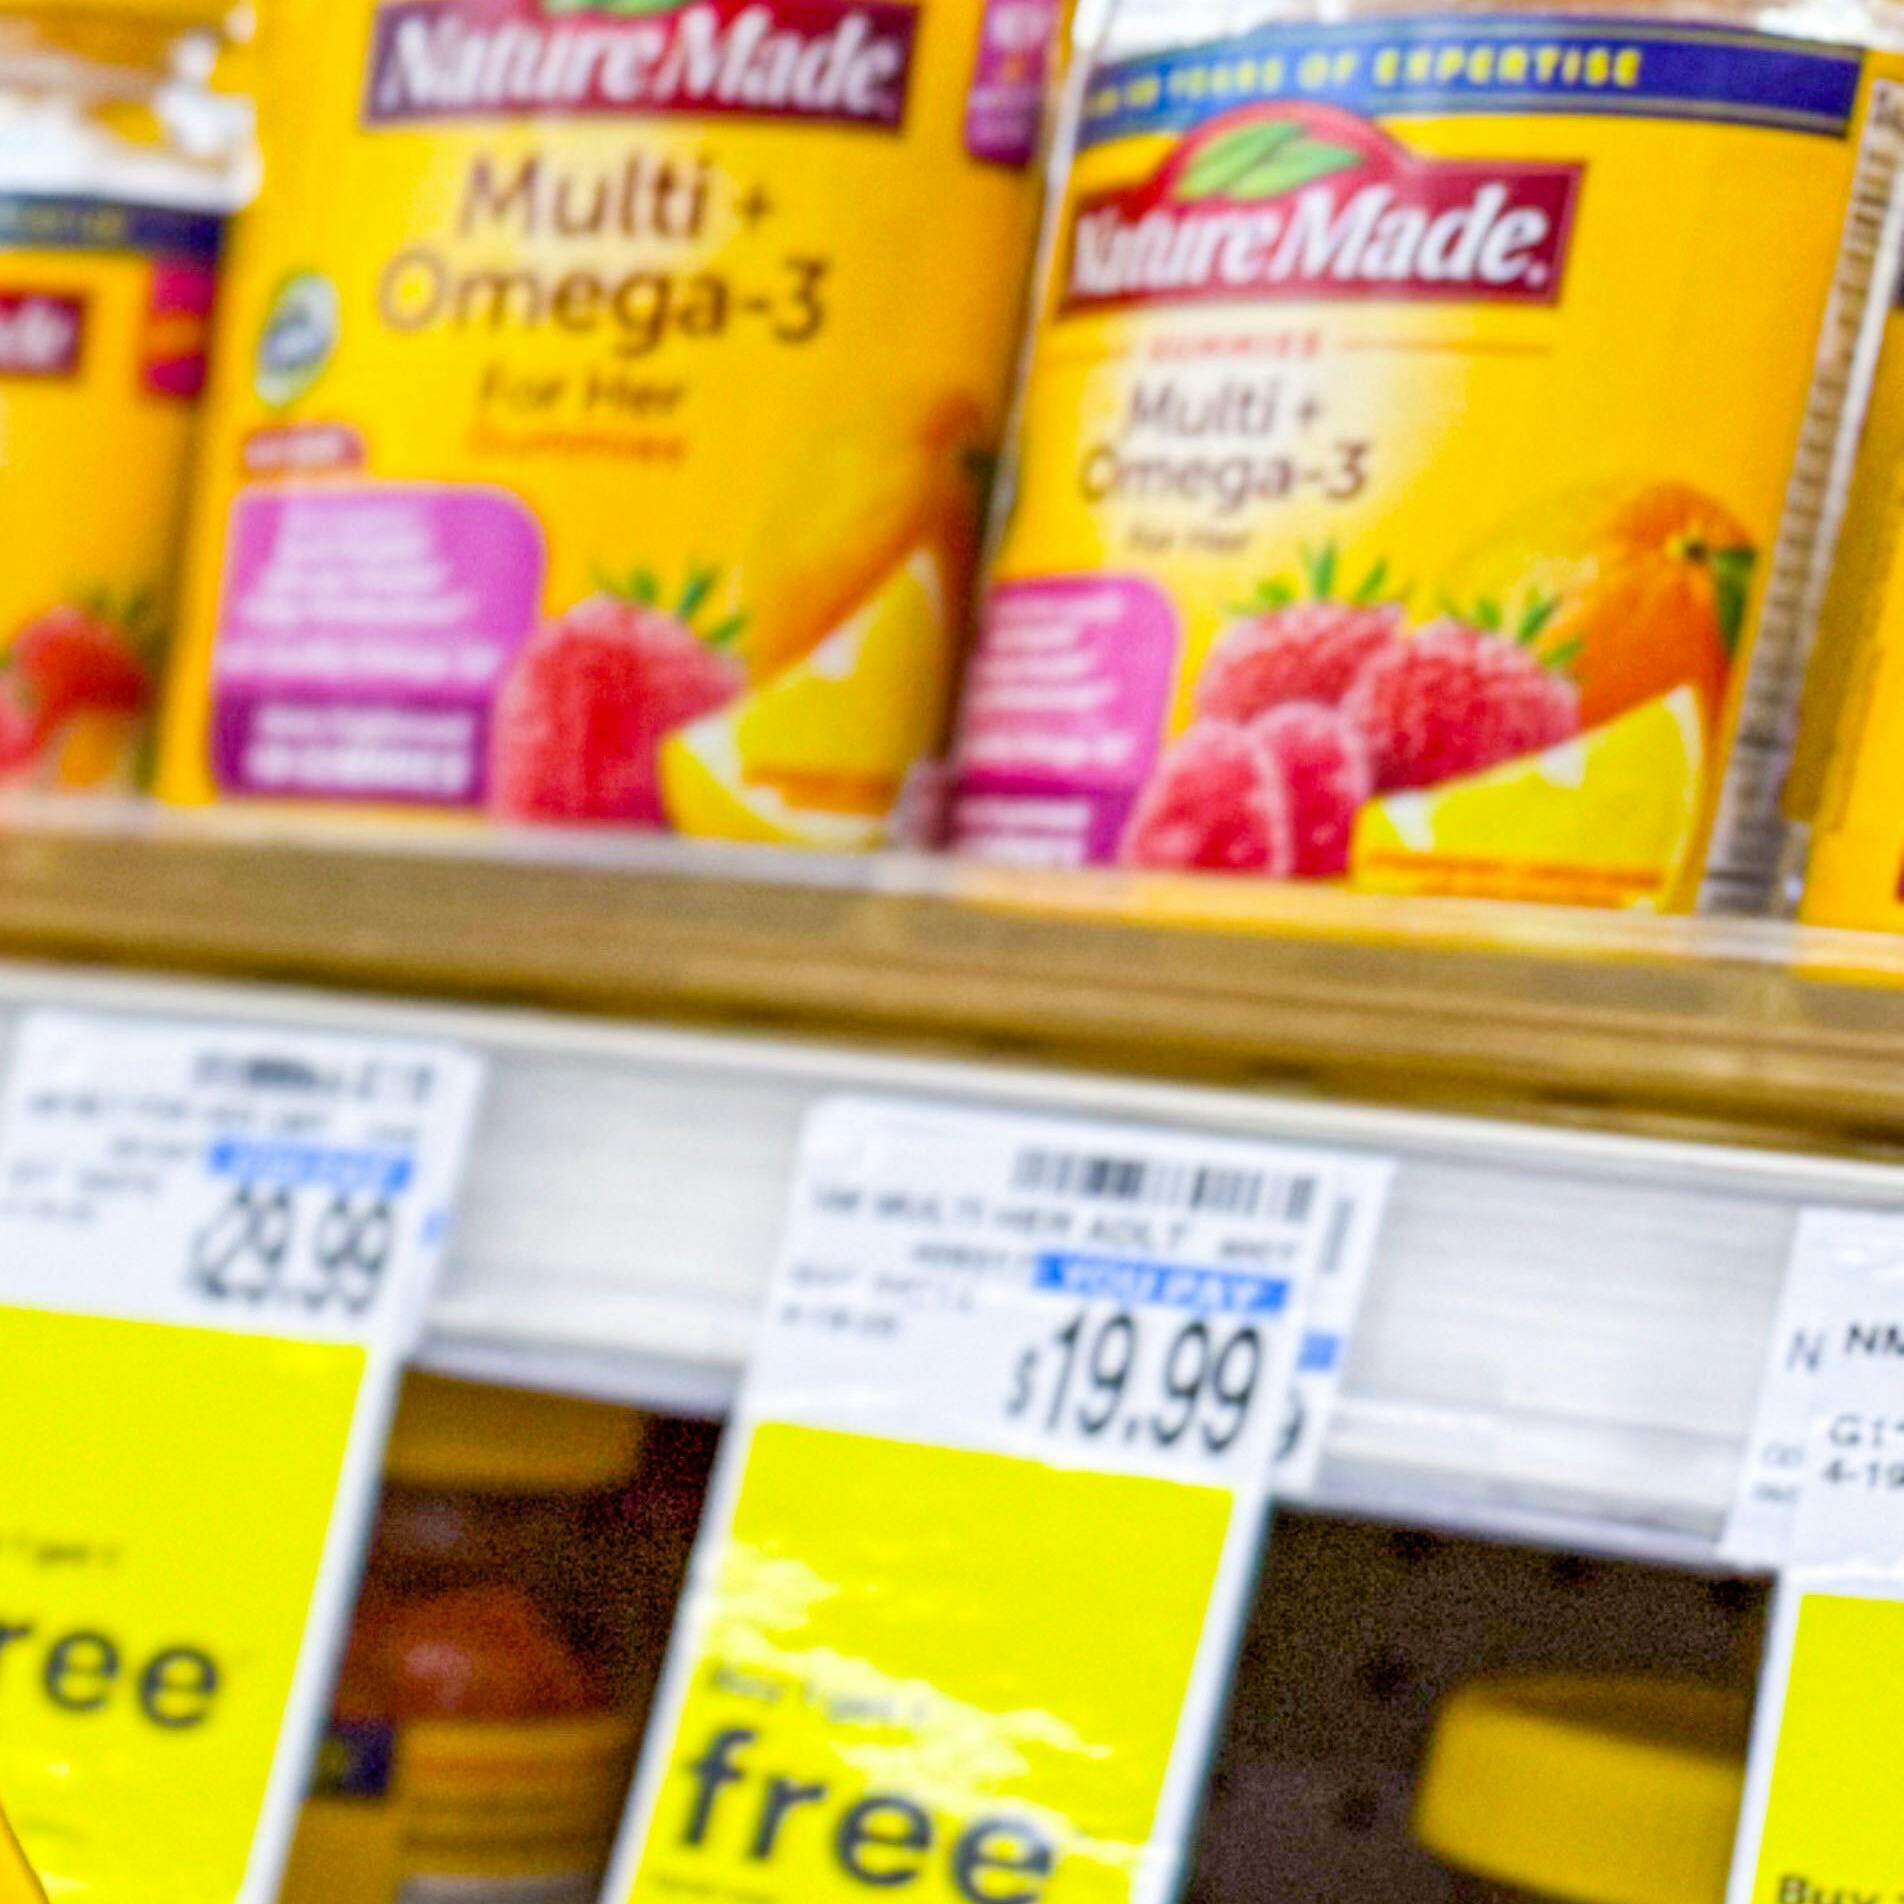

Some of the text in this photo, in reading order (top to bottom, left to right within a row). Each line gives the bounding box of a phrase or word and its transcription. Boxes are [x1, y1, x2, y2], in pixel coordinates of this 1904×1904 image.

[1374, 46, 1644, 89] EXPERTISE
[459, 148, 718, 243] Multi
[378, 256, 834, 356] Omega-3
[587, 368, 686, 416] Her
[1124, 375, 1276, 440] Multi
[1080, 442, 1372, 510] Omega-3
[1006, 1308, 1264, 1455] $19.99
